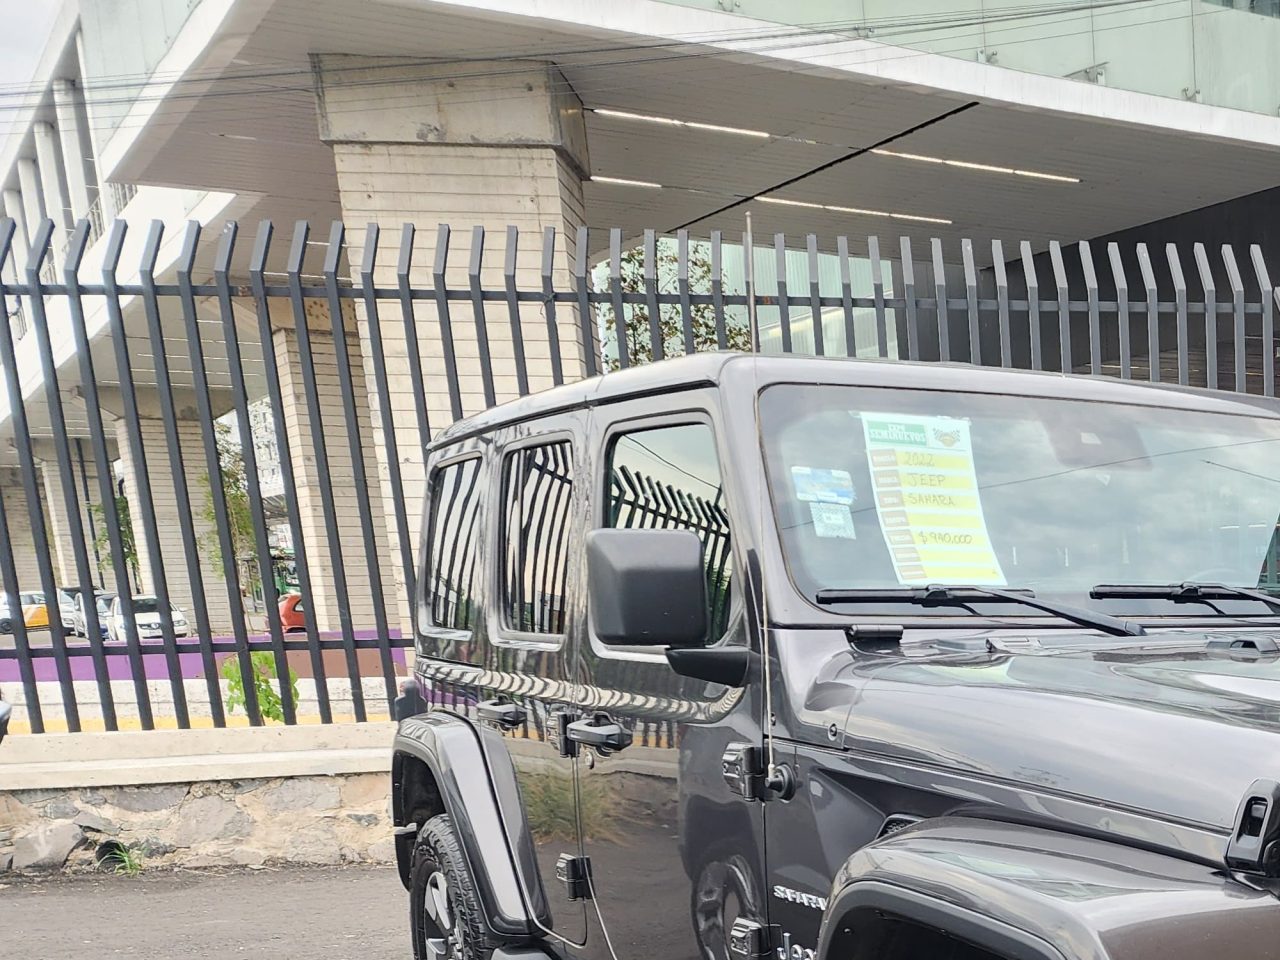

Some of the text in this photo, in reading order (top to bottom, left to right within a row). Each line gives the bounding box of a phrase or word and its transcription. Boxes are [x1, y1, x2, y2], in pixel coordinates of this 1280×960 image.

[869, 429, 926, 442] SEMINUEVOS
[904, 452, 935, 467] 2022
[907, 472, 945, 487] JEEP
[908, 492, 956, 506] SAHARA
